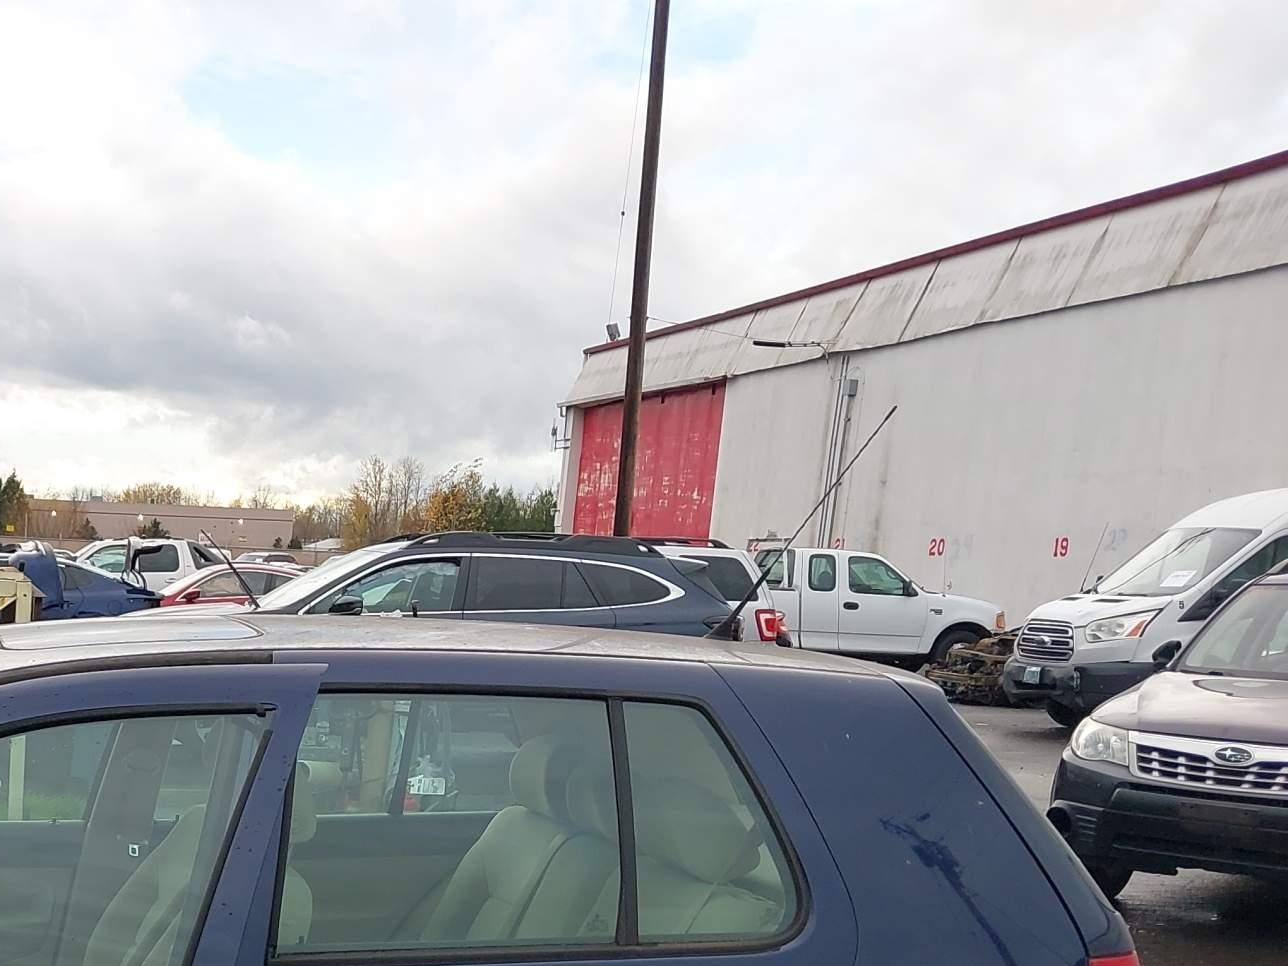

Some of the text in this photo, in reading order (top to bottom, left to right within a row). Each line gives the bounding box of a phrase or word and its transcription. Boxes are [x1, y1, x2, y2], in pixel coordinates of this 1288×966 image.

[928, 538, 945, 556] 20
[1053, 537, 1069, 557] 19
[1178, 601, 1185, 609] 5
